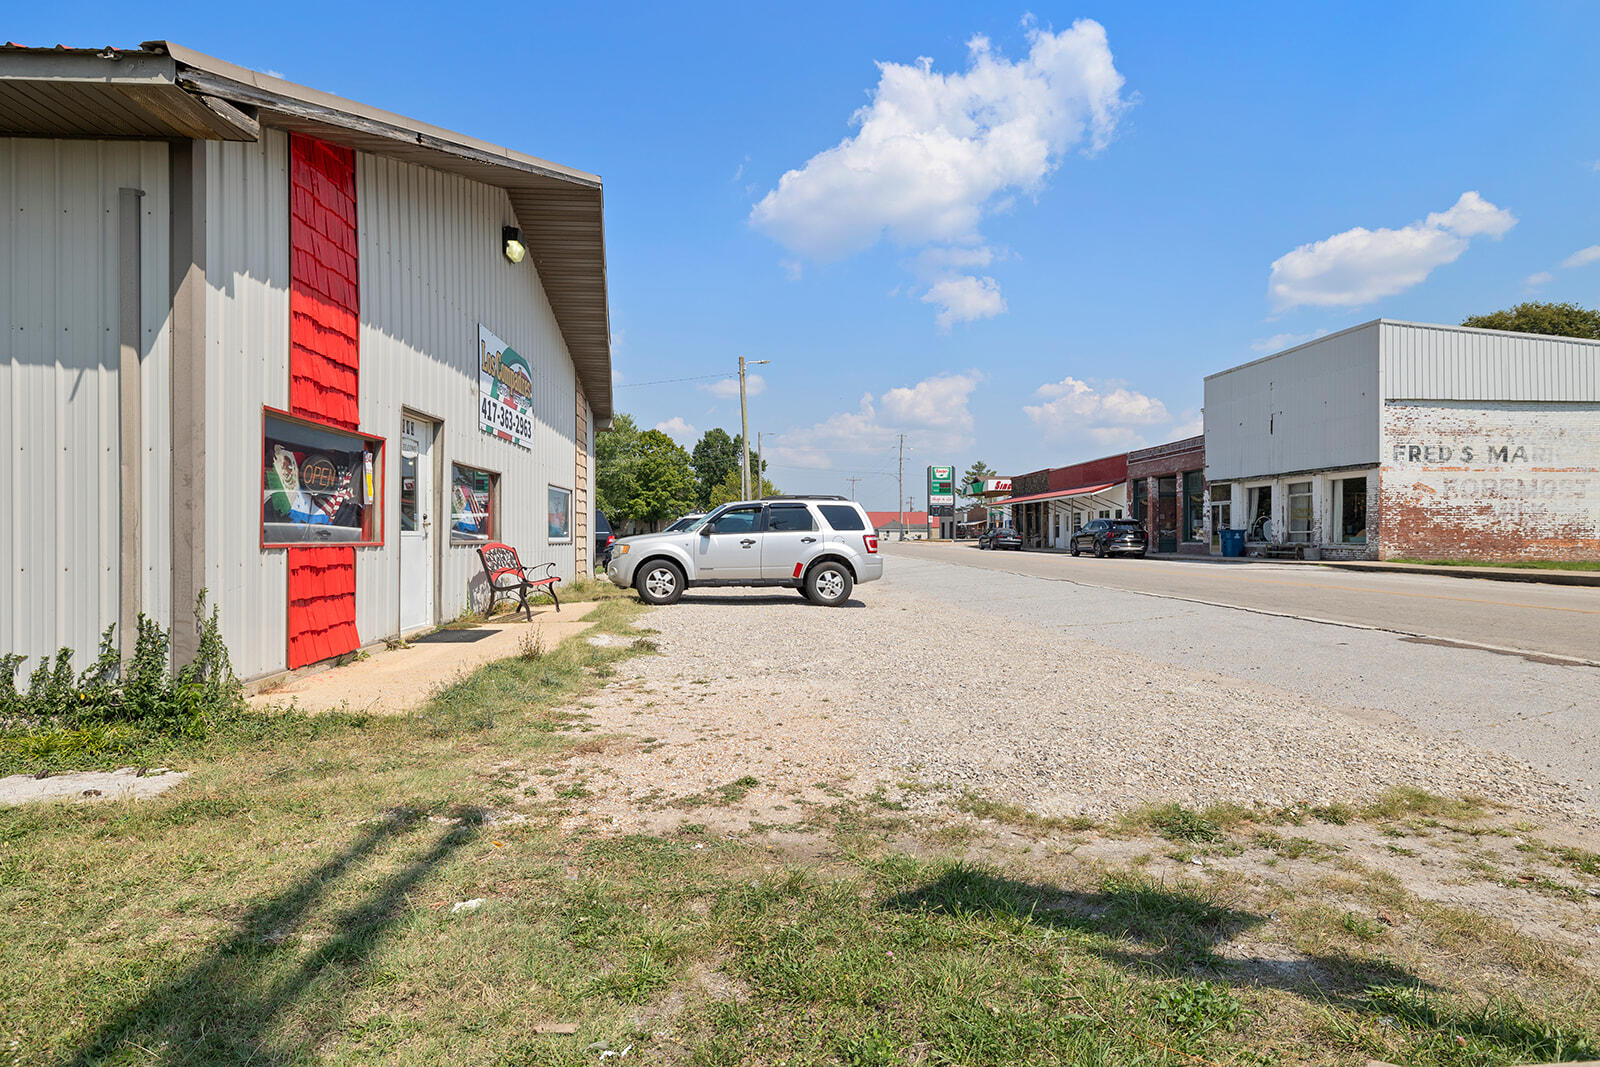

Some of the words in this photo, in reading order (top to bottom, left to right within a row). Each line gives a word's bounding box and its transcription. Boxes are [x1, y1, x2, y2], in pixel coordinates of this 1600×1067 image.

[481, 339, 496, 378] Los
[496, 350, 531, 401] Compadres
[481, 397, 532, 439] 417-363-2963
[303, 464, 337, 488] OPEN
